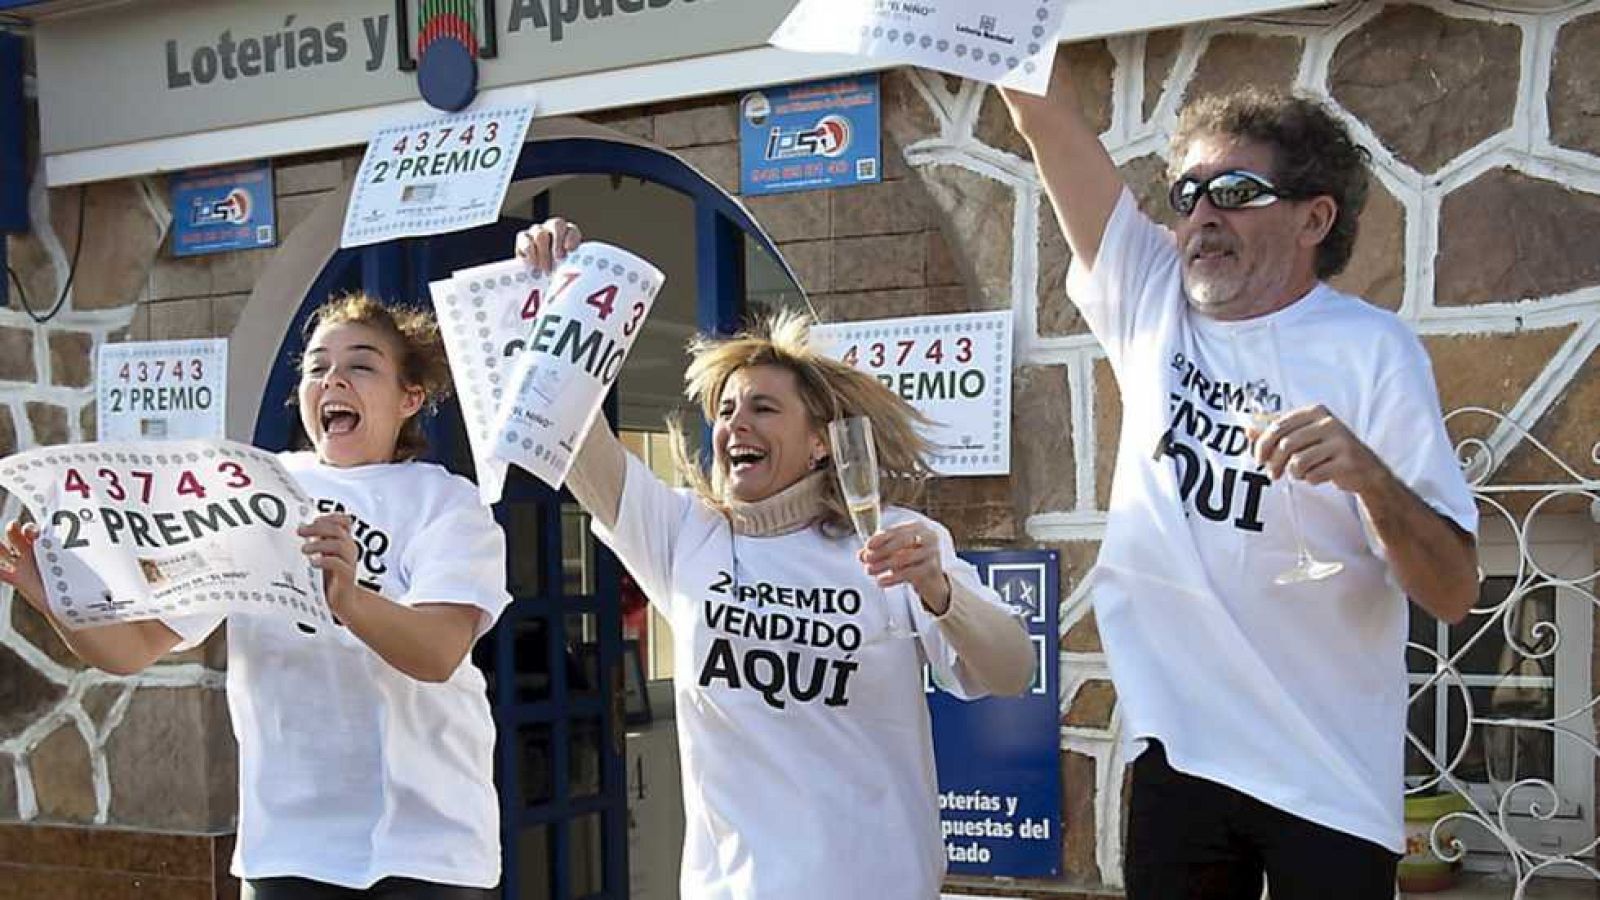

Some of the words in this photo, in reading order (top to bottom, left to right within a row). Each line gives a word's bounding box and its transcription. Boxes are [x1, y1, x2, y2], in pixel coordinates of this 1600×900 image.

[166, 14, 348, 88] Loterías
[362, 14, 389, 71] y
[393, 122, 499, 155] 43743
[395, 146, 501, 181] PREMIO
[530, 314, 626, 386] EMIO
[119, 358, 203, 384] 43743
[130, 386, 212, 411] PREMIO
[64, 461, 252, 504] 43743
[100, 493, 286, 548] PREMIO
[739, 582, 862, 615] PREMIO
[705, 600, 862, 651] VENDIDO
[699, 637, 859, 710] AQUÍ
[938, 789, 1001, 811] oterías
[1005, 796, 1018, 817] y
[942, 817, 1014, 839] puestas
[1019, 818, 1051, 839] del
[948, 842, 991, 863] tado
